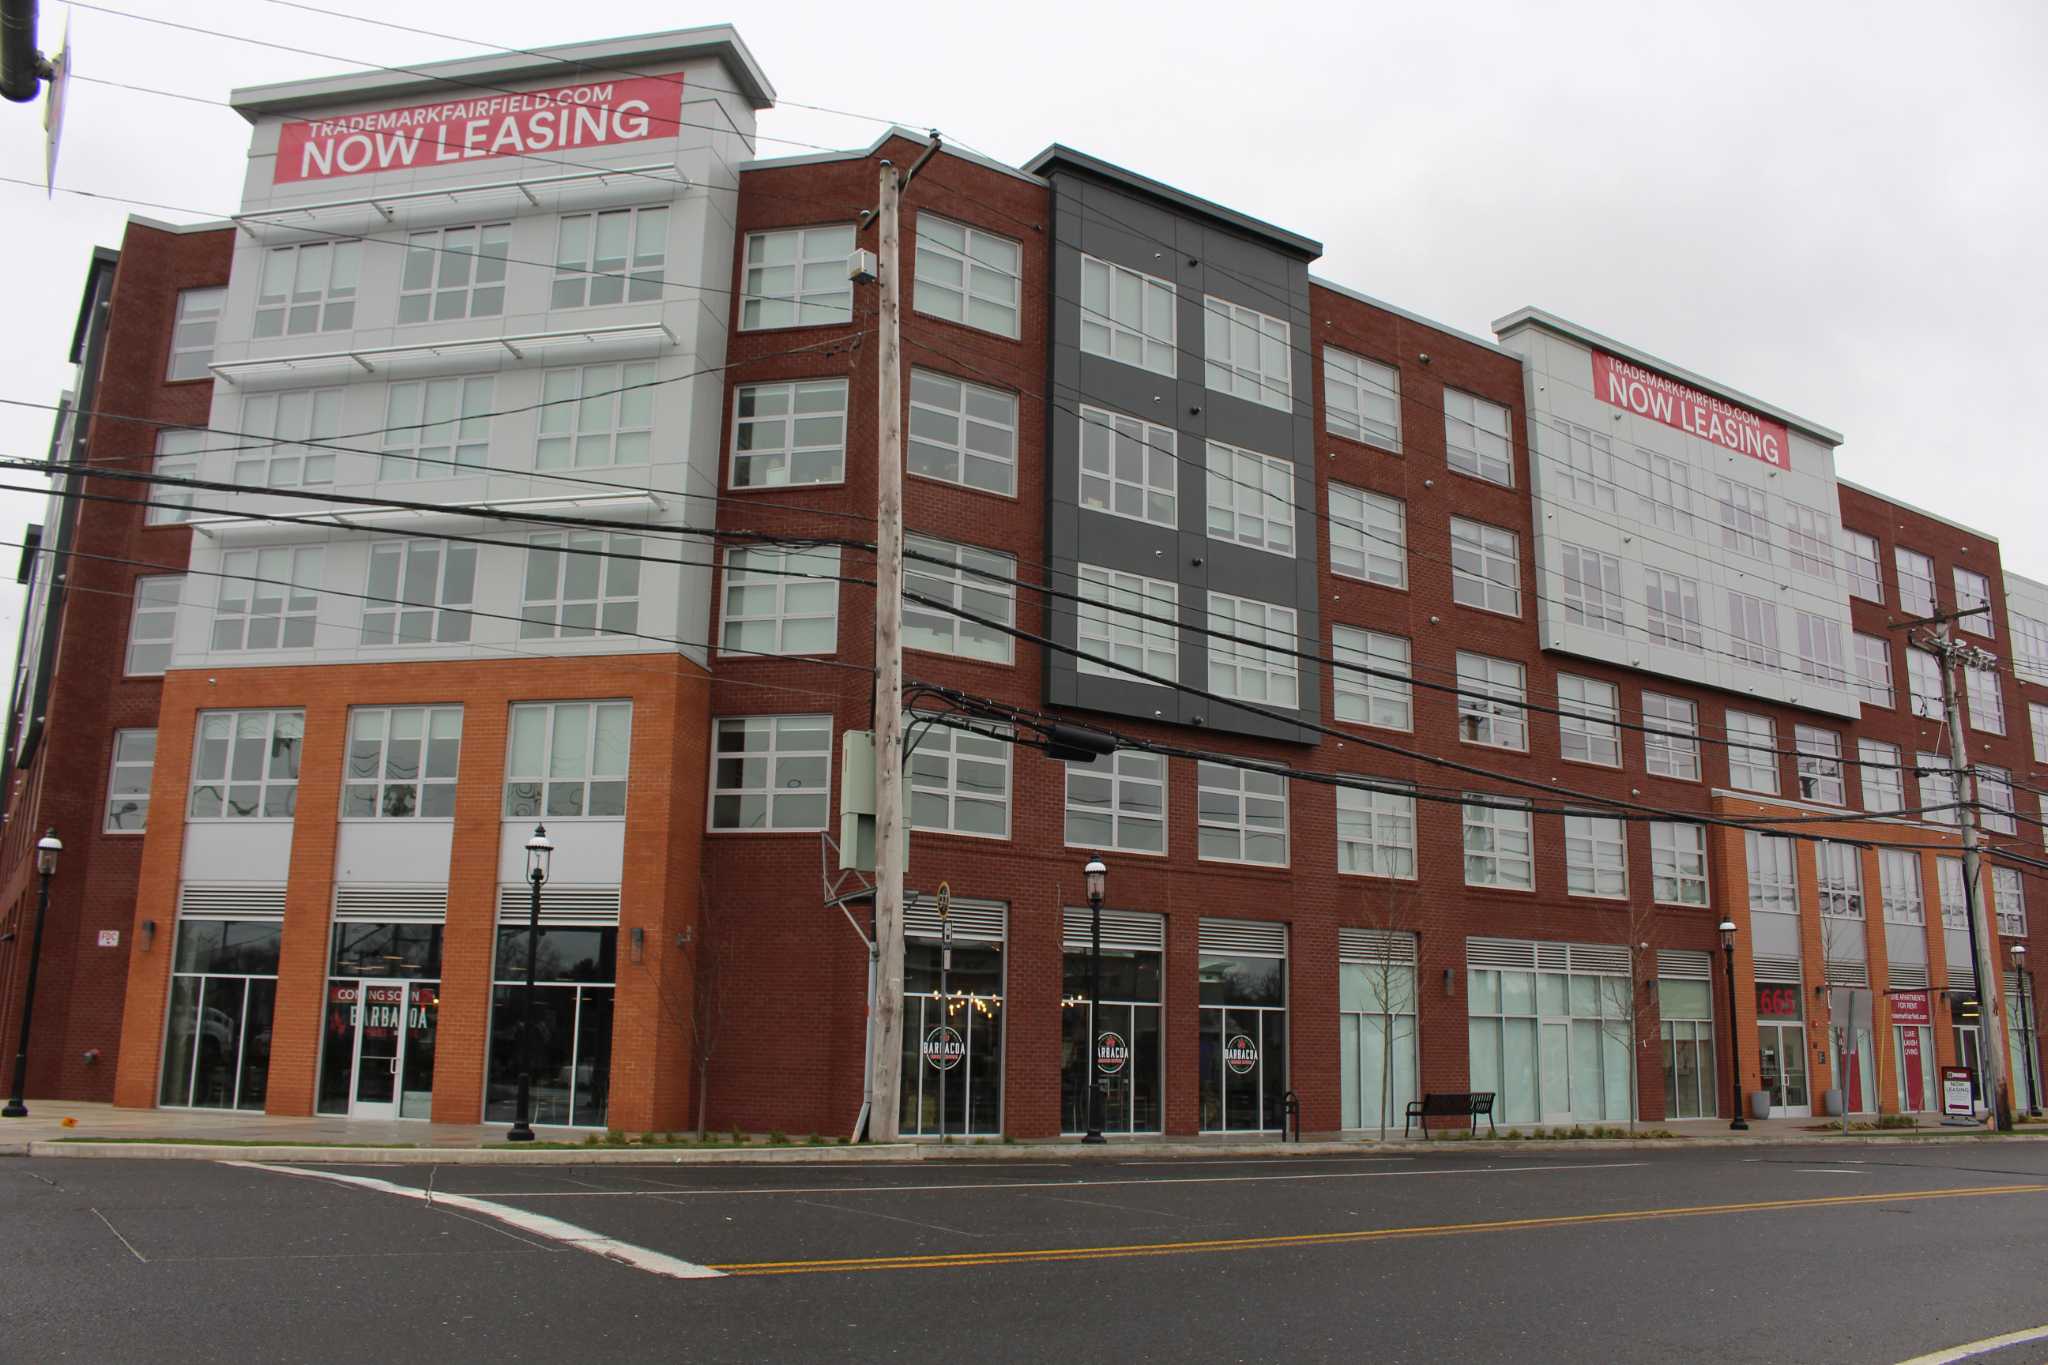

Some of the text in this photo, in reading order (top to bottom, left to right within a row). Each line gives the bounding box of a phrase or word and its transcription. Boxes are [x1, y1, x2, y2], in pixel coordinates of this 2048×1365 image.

[300, 99, 650, 178] NOW LEASING
[309, 84, 613, 138] TRADEMARKFAIRFIELD.COM
[1607, 356, 1761, 428] TRADEMARKFAIRFIELD.COM
[1608, 372, 1780, 465] NOW LEASING
